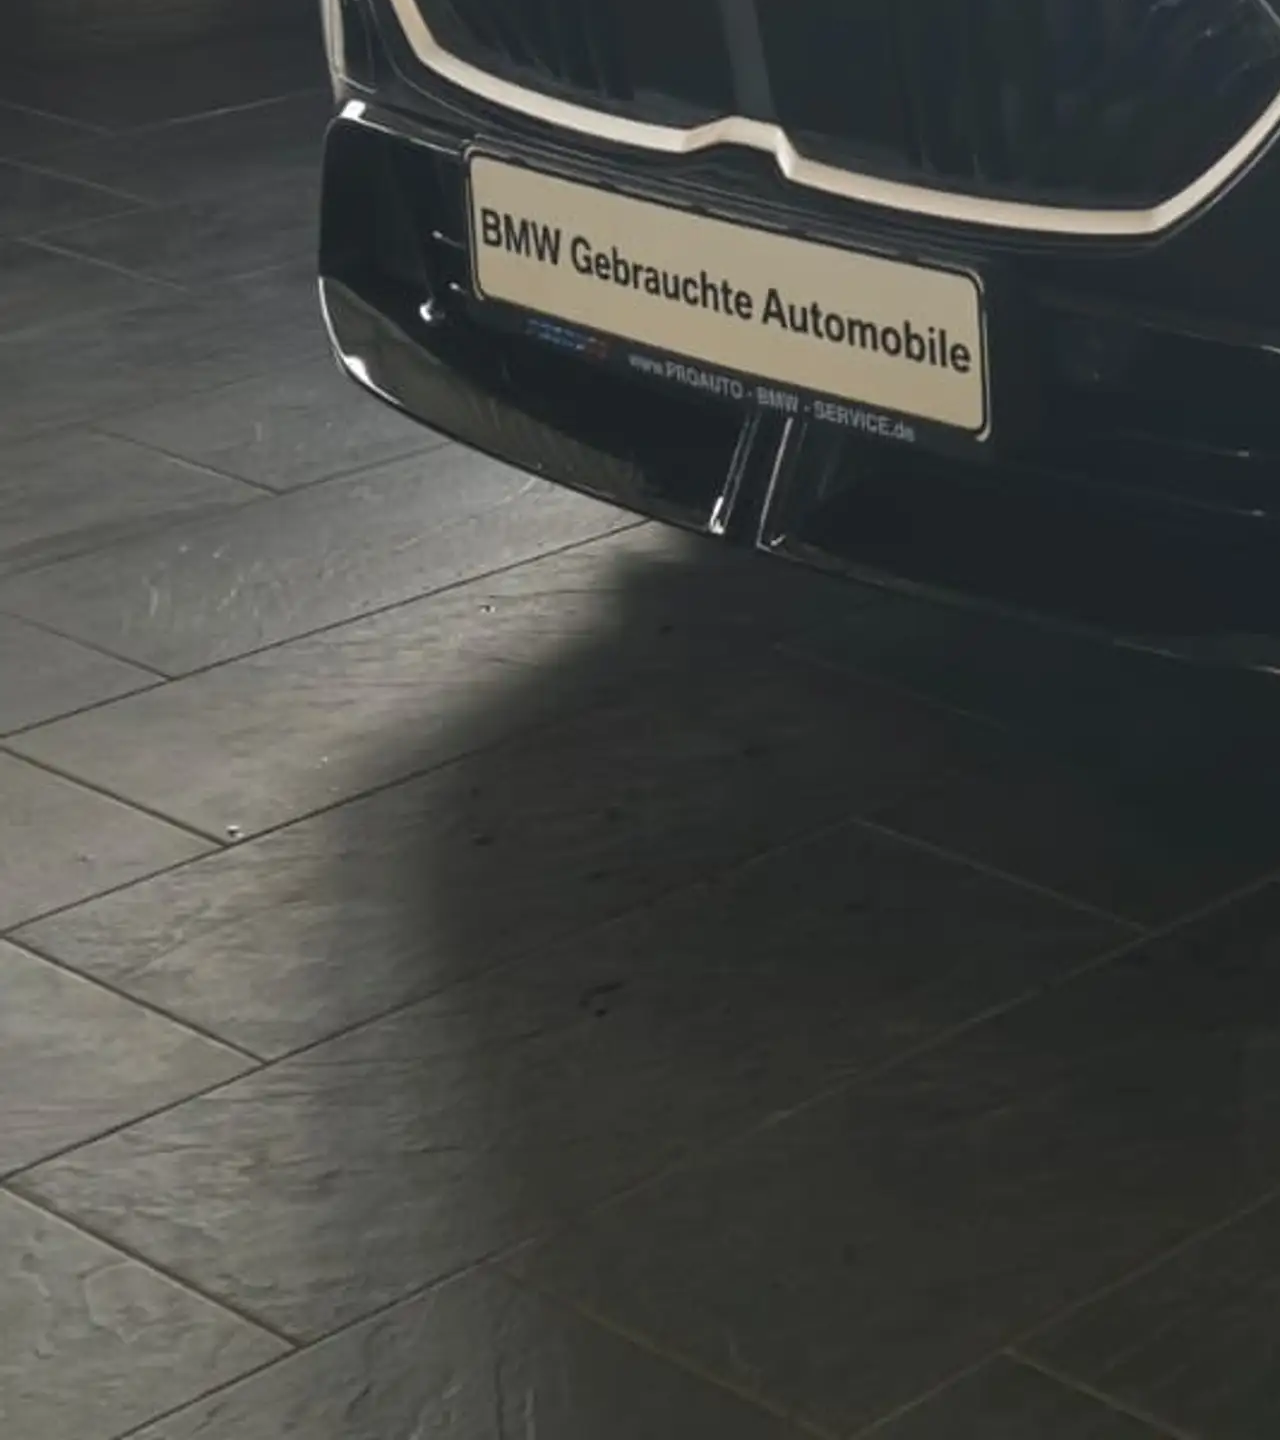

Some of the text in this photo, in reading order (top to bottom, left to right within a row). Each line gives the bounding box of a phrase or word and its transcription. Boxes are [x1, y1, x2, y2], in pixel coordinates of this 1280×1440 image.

[481, 208, 972, 374] BMW Gebrauchte Automobile
[757, 386, 799, 414] BMW
